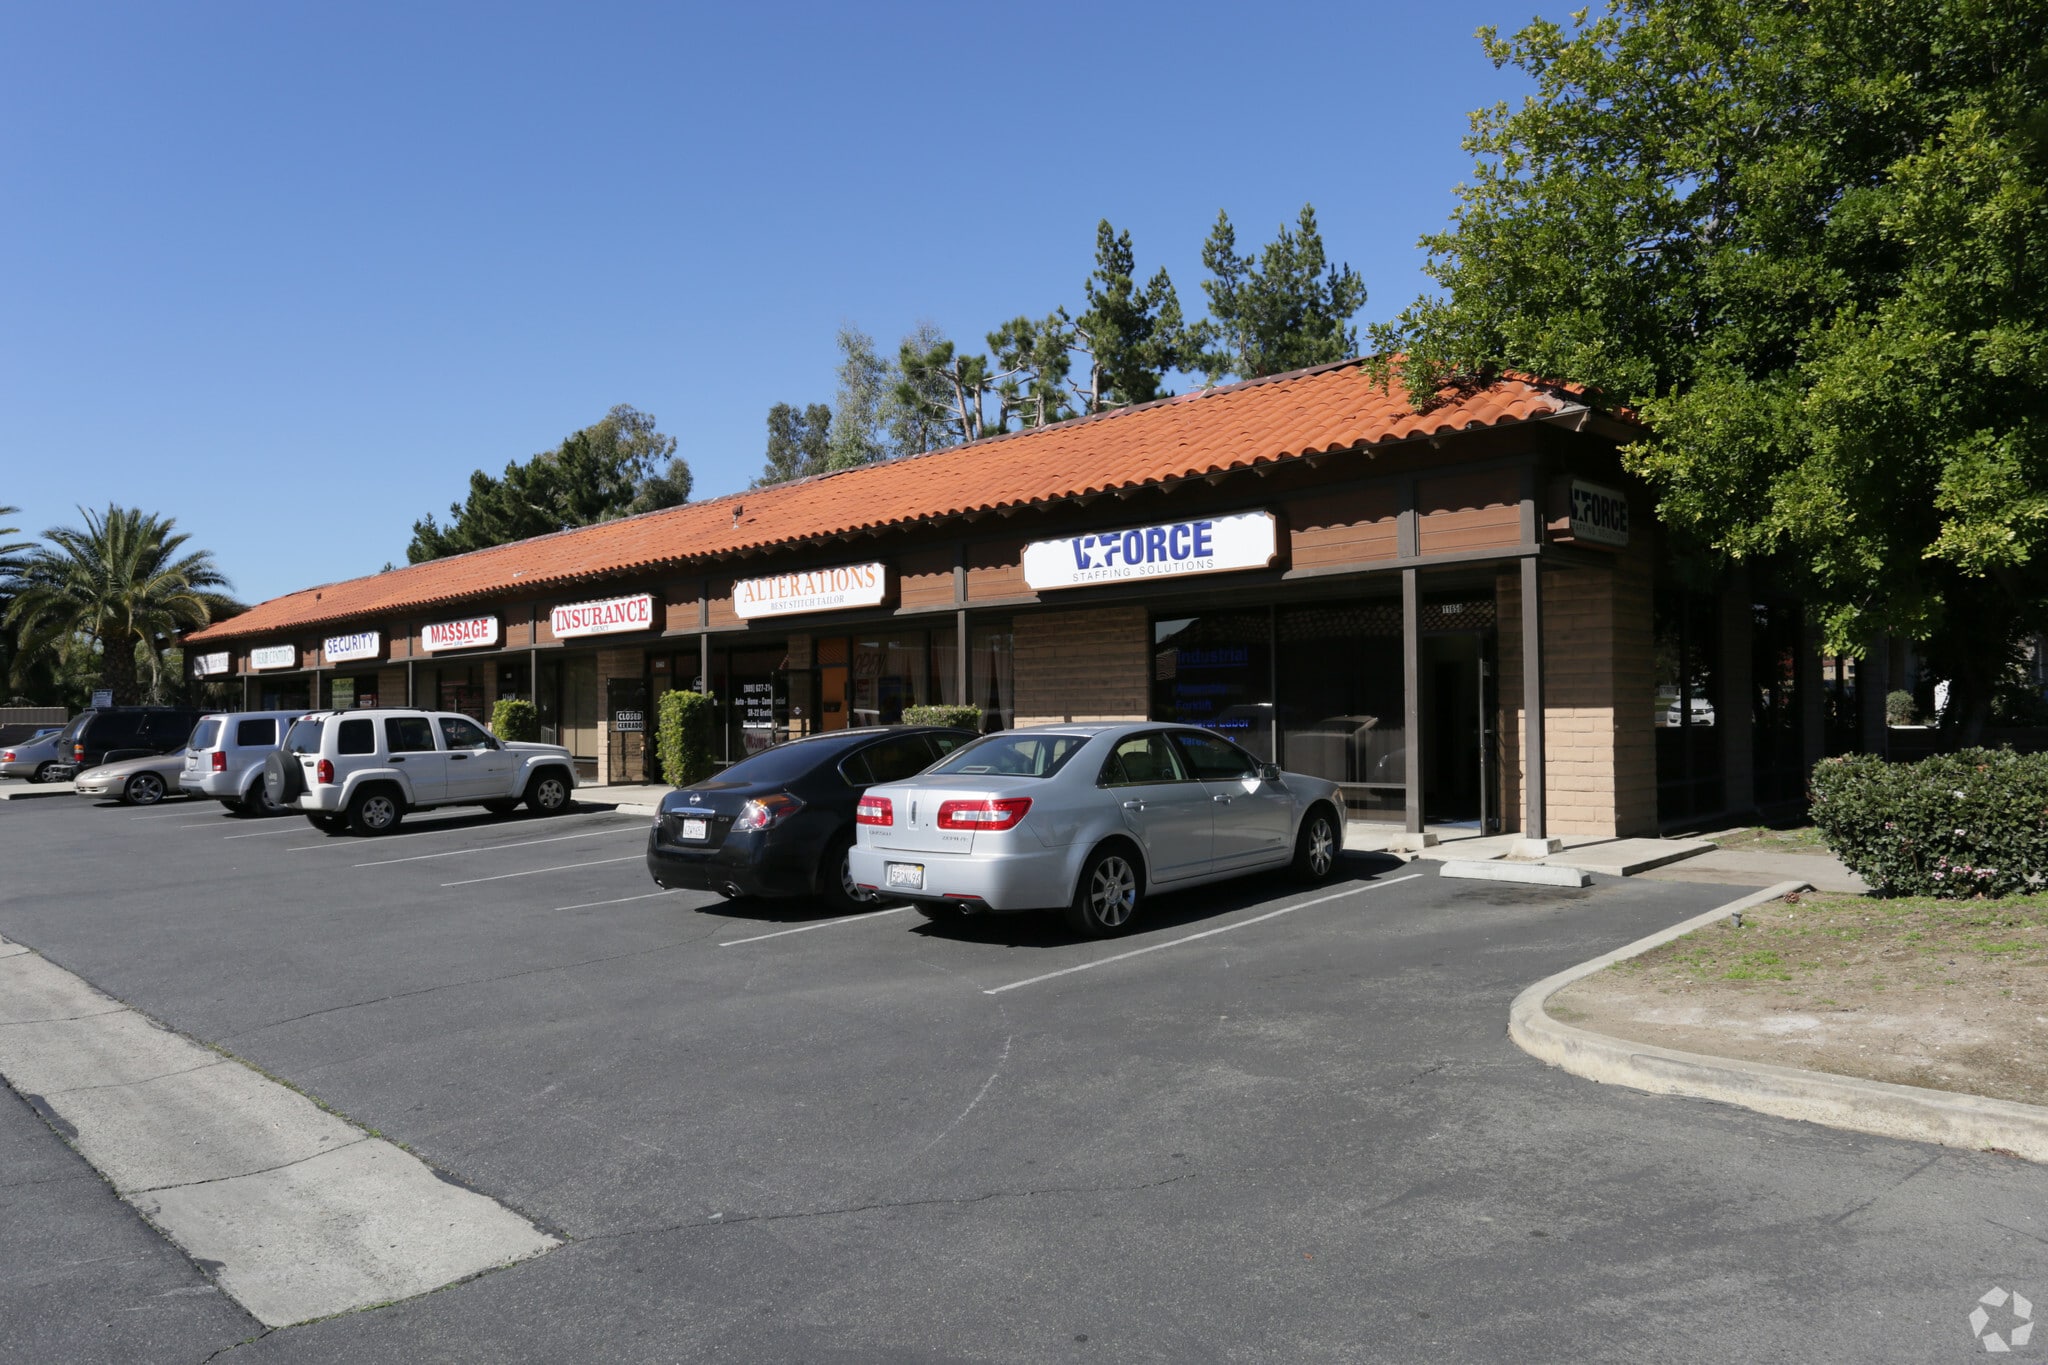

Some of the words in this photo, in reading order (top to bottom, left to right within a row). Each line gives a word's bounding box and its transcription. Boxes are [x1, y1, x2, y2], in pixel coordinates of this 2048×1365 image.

[1072, 567, 1131, 583] STAFFING
[1139, 558, 1214, 576] SOLUTIONS
[743, 565, 876, 603] ALTERATIONS
[770, 600, 787, 611] BEST
[788, 597, 815, 609] STITCH
[817, 594, 845, 606] TAILOR
[555, 597, 649, 632] INSURANCE
[430, 618, 489, 644] MASSAGE
[327, 632, 375, 654] SECURITY
[1177, 646, 1249, 665] Industrial
[617, 721, 643, 729] CERRADO
[618, 712, 642, 721] CLOSED
